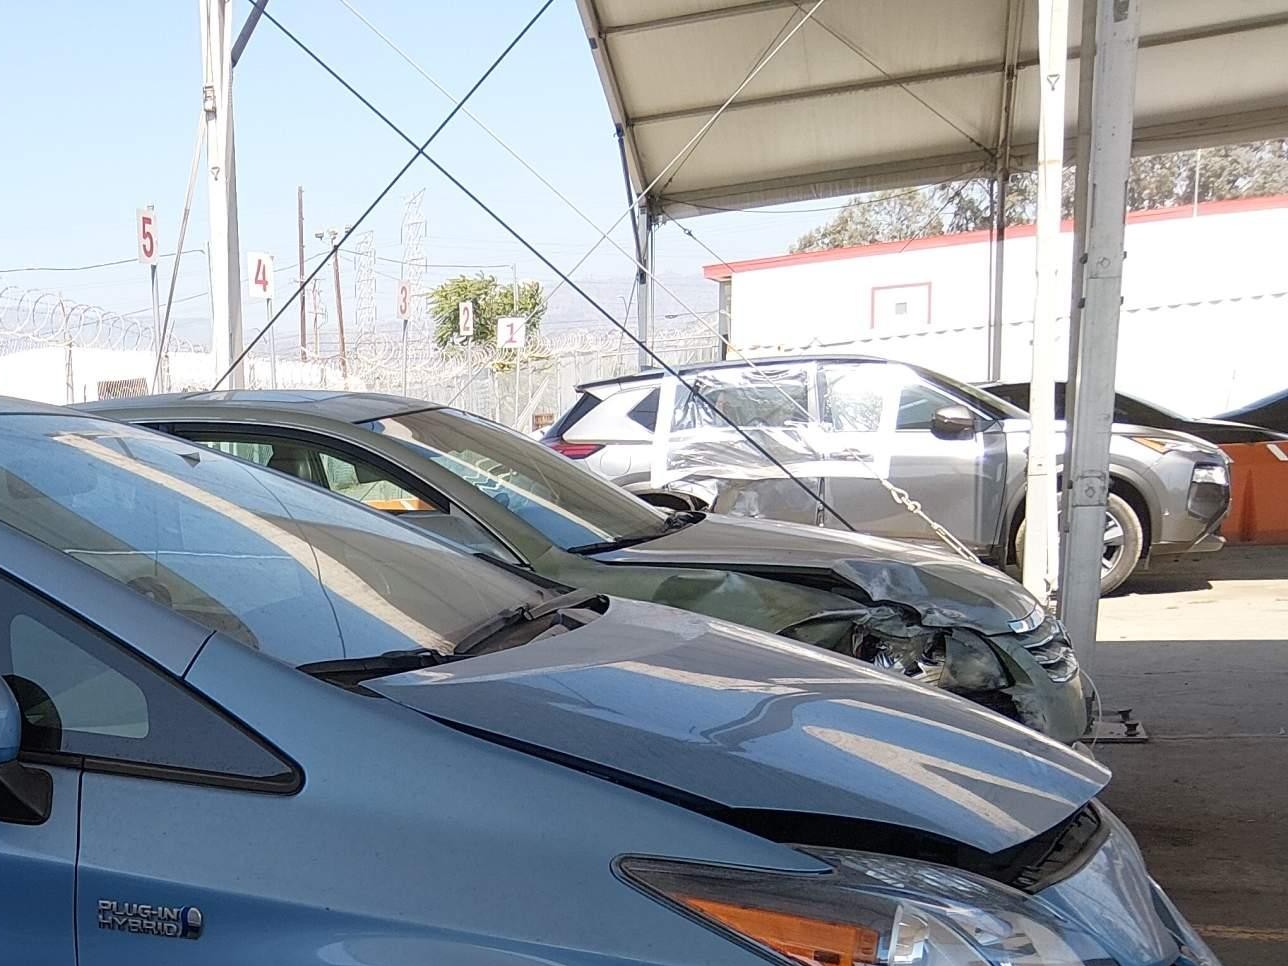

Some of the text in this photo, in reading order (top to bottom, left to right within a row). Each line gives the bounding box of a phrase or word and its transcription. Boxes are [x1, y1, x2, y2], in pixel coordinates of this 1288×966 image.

[141, 216, 154, 258] 5
[254, 258, 269, 293] 4
[399, 286, 408, 315] 3
[462, 306, 470, 332] 2
[505, 322, 517, 344] 1
[98, 899, 179, 921] PLUG-IN
[98, 913, 178, 937] HYBRID
